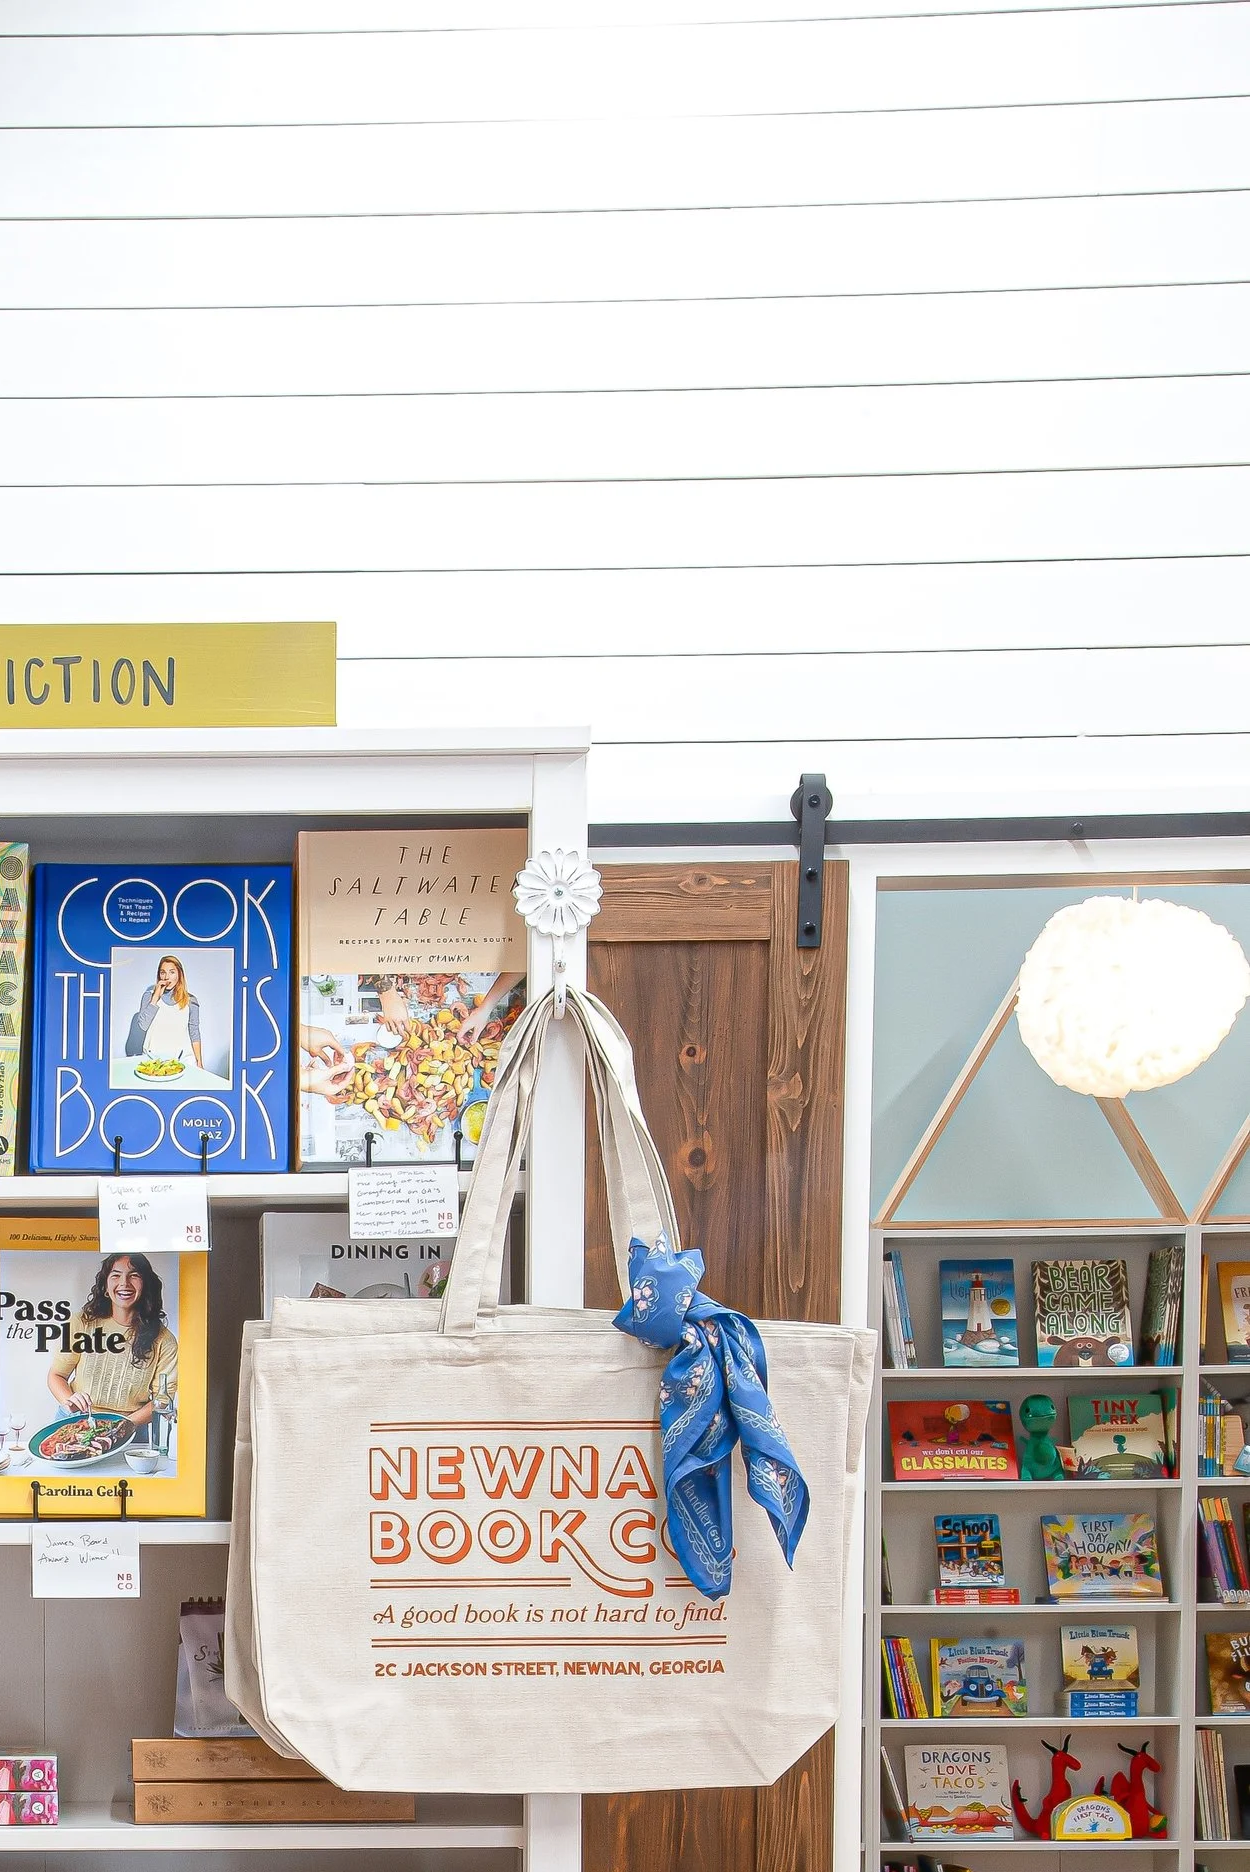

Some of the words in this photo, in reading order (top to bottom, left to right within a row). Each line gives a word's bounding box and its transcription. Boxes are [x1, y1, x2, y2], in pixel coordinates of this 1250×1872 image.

[399, 846, 452, 864] THE
[57, 877, 279, 970] COOK
[374, 907, 472, 926] TABLE
[54, 1067, 277, 1161] BOOK
[183, 1119, 222, 1127] MOLLY
[331, 1243, 410, 1260] DINING
[419, 1244, 442, 1259] IN
[1049, 1264, 1112, 1292] BEAR
[1044, 1291, 1115, 1313] CAME
[1044, 1312, 1121, 1336] ALONG
[6, 1322, 33, 1341] the
[34, 1324, 126, 1354] Plate
[1091, 1400, 1140, 1415] TINY
[1110, 1415, 1139, 1425] REX
[901, 1456, 1008, 1471] CLASSMATES
[369, 1445, 658, 1500] NEWNA
[37, 1485, 93, 1498] Carolina
[941, 1517, 995, 1537] School
[1082, 1520, 1114, 1534] FIRST
[1087, 1531, 1108, 1544] DAY
[1073, 1539, 1131, 1555] HOORAY!
[373, 1604, 395, 1624] A
[402, 1604, 459, 1628] good
[465, 1603, 520, 1623] book
[525, 1604, 544, 1622] is
[550, 1605, 588, 1623] not
[593, 1603, 649, 1622] hard
[655, 1606, 675, 1622] to
[673, 1601, 728, 1630] find.
[1069, 1630, 1089, 1640] Little
[375, 1662, 397, 1677] 2C
[402, 1662, 487, 1677] JACKSON
[492, 1661, 560, 1677] STREET,
[564, 1661, 645, 1676] NEWNAN,
[649, 1660, 725, 1675] GEORGIA
[922, 1751, 991, 1764] DRAGONS
[937, 1764, 978, 1776] LOVE
[931, 1776, 986, 1789] TACOS
